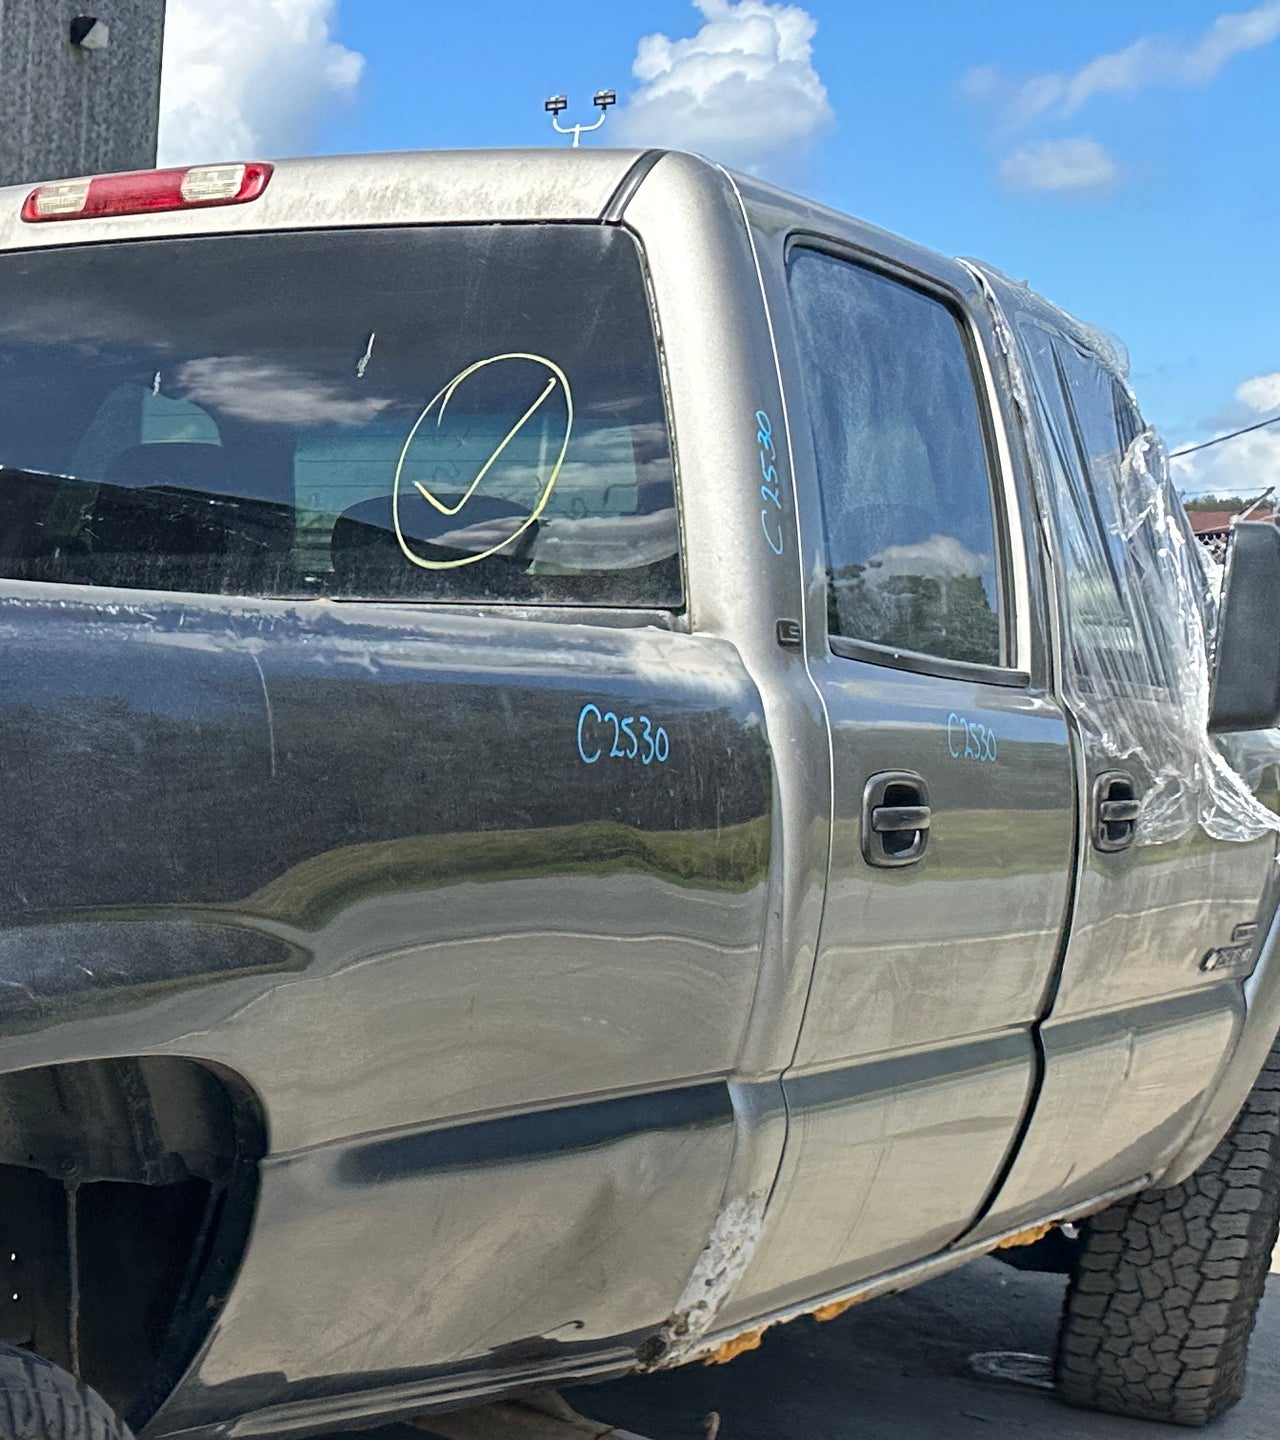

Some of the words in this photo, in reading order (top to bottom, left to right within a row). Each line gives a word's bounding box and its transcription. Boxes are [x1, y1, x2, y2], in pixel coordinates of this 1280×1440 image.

[754, 410, 784, 555] C2530
[577, 703, 670, 763] C2530
[948, 712, 997, 762] C2530
